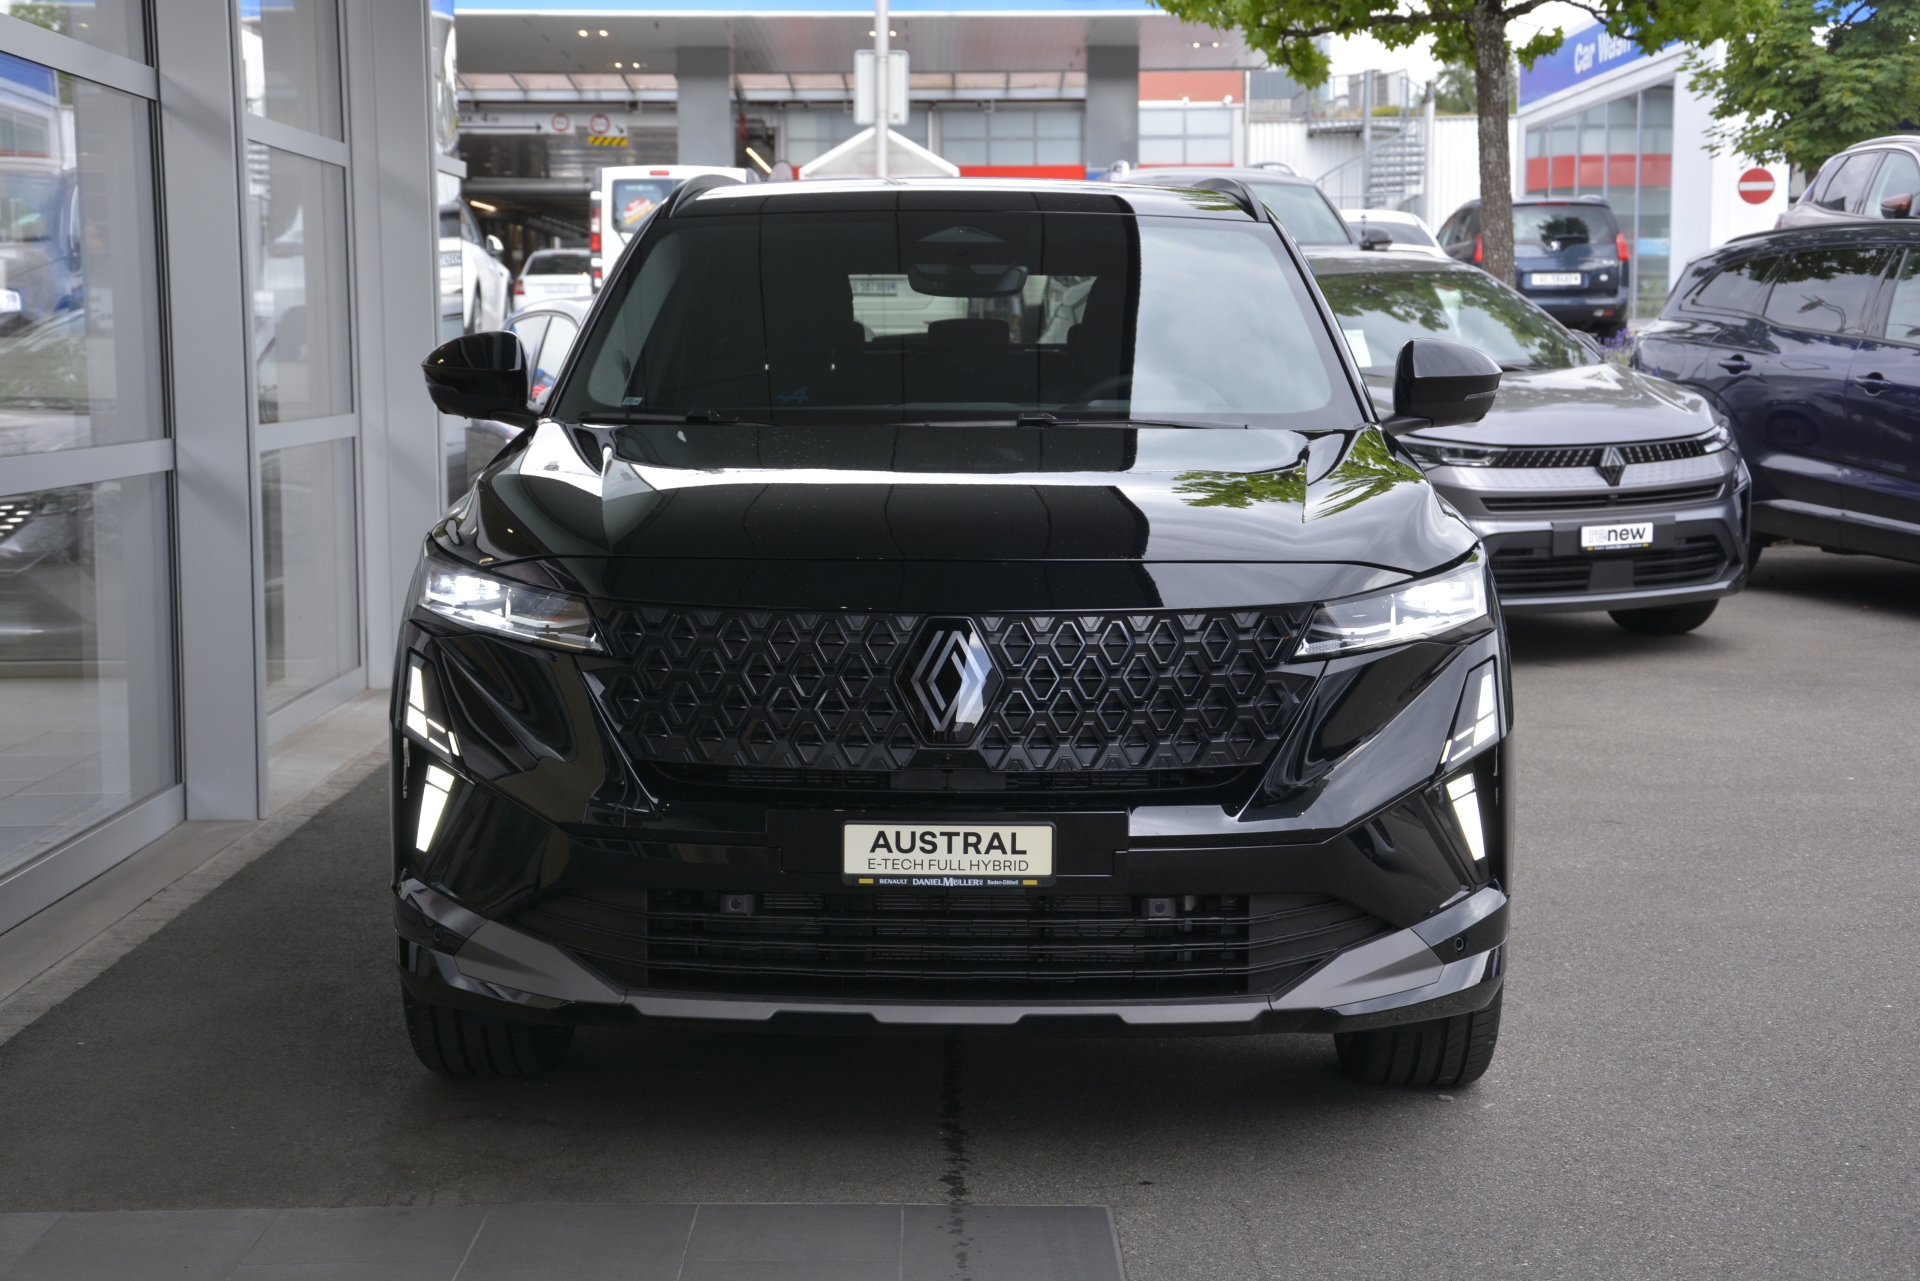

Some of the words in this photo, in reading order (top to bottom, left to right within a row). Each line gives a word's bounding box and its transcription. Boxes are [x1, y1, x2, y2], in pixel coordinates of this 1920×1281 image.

[1574, 42, 1596, 75] Car
[1597, 27, 1632, 64] Wash
[1588, 527, 1646, 543] renew
[869, 830, 1027, 855] AUSTRAL
[868, 858, 924, 871] E-TECH
[928, 859, 965, 871] FULL
[969, 859, 1029, 872] HYBRID
